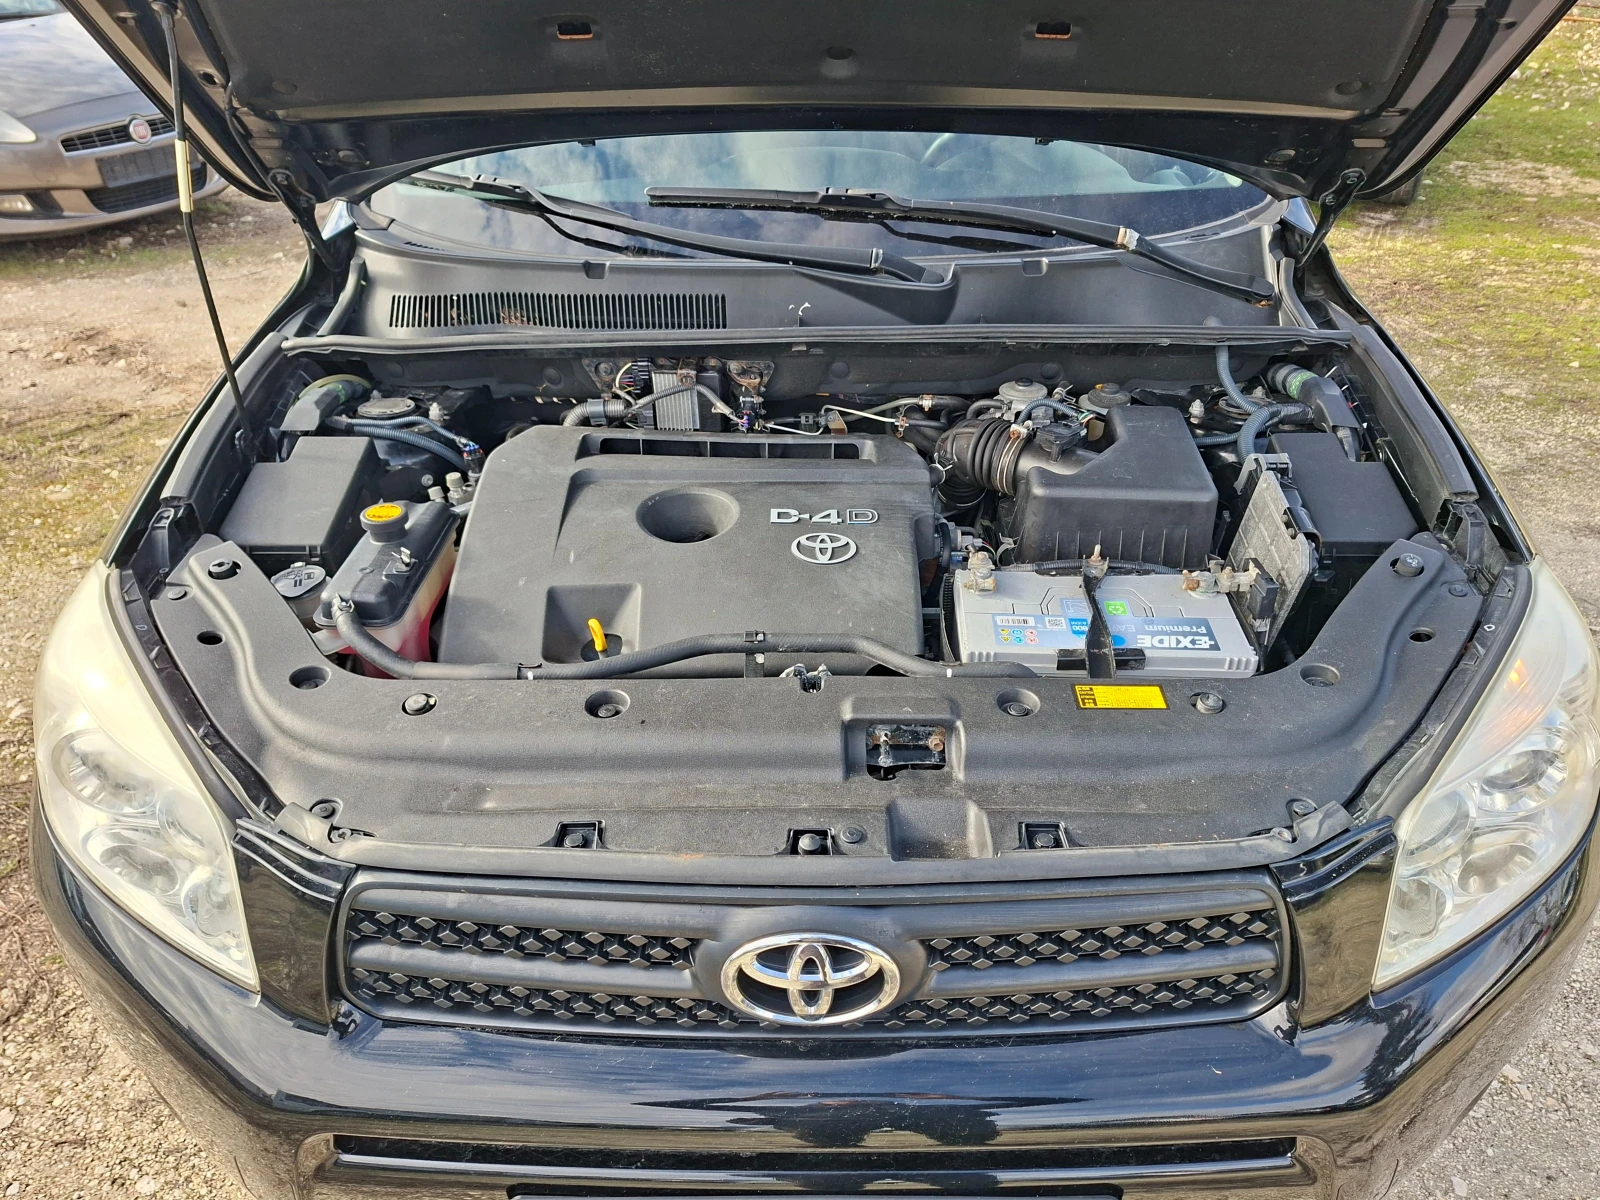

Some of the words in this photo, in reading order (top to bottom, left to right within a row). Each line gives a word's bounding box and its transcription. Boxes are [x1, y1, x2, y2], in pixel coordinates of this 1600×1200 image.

[770, 508, 879, 525] D-4D
[1145, 624, 1207, 634] Premium
[1137, 635, 1215, 649] EXIDE
